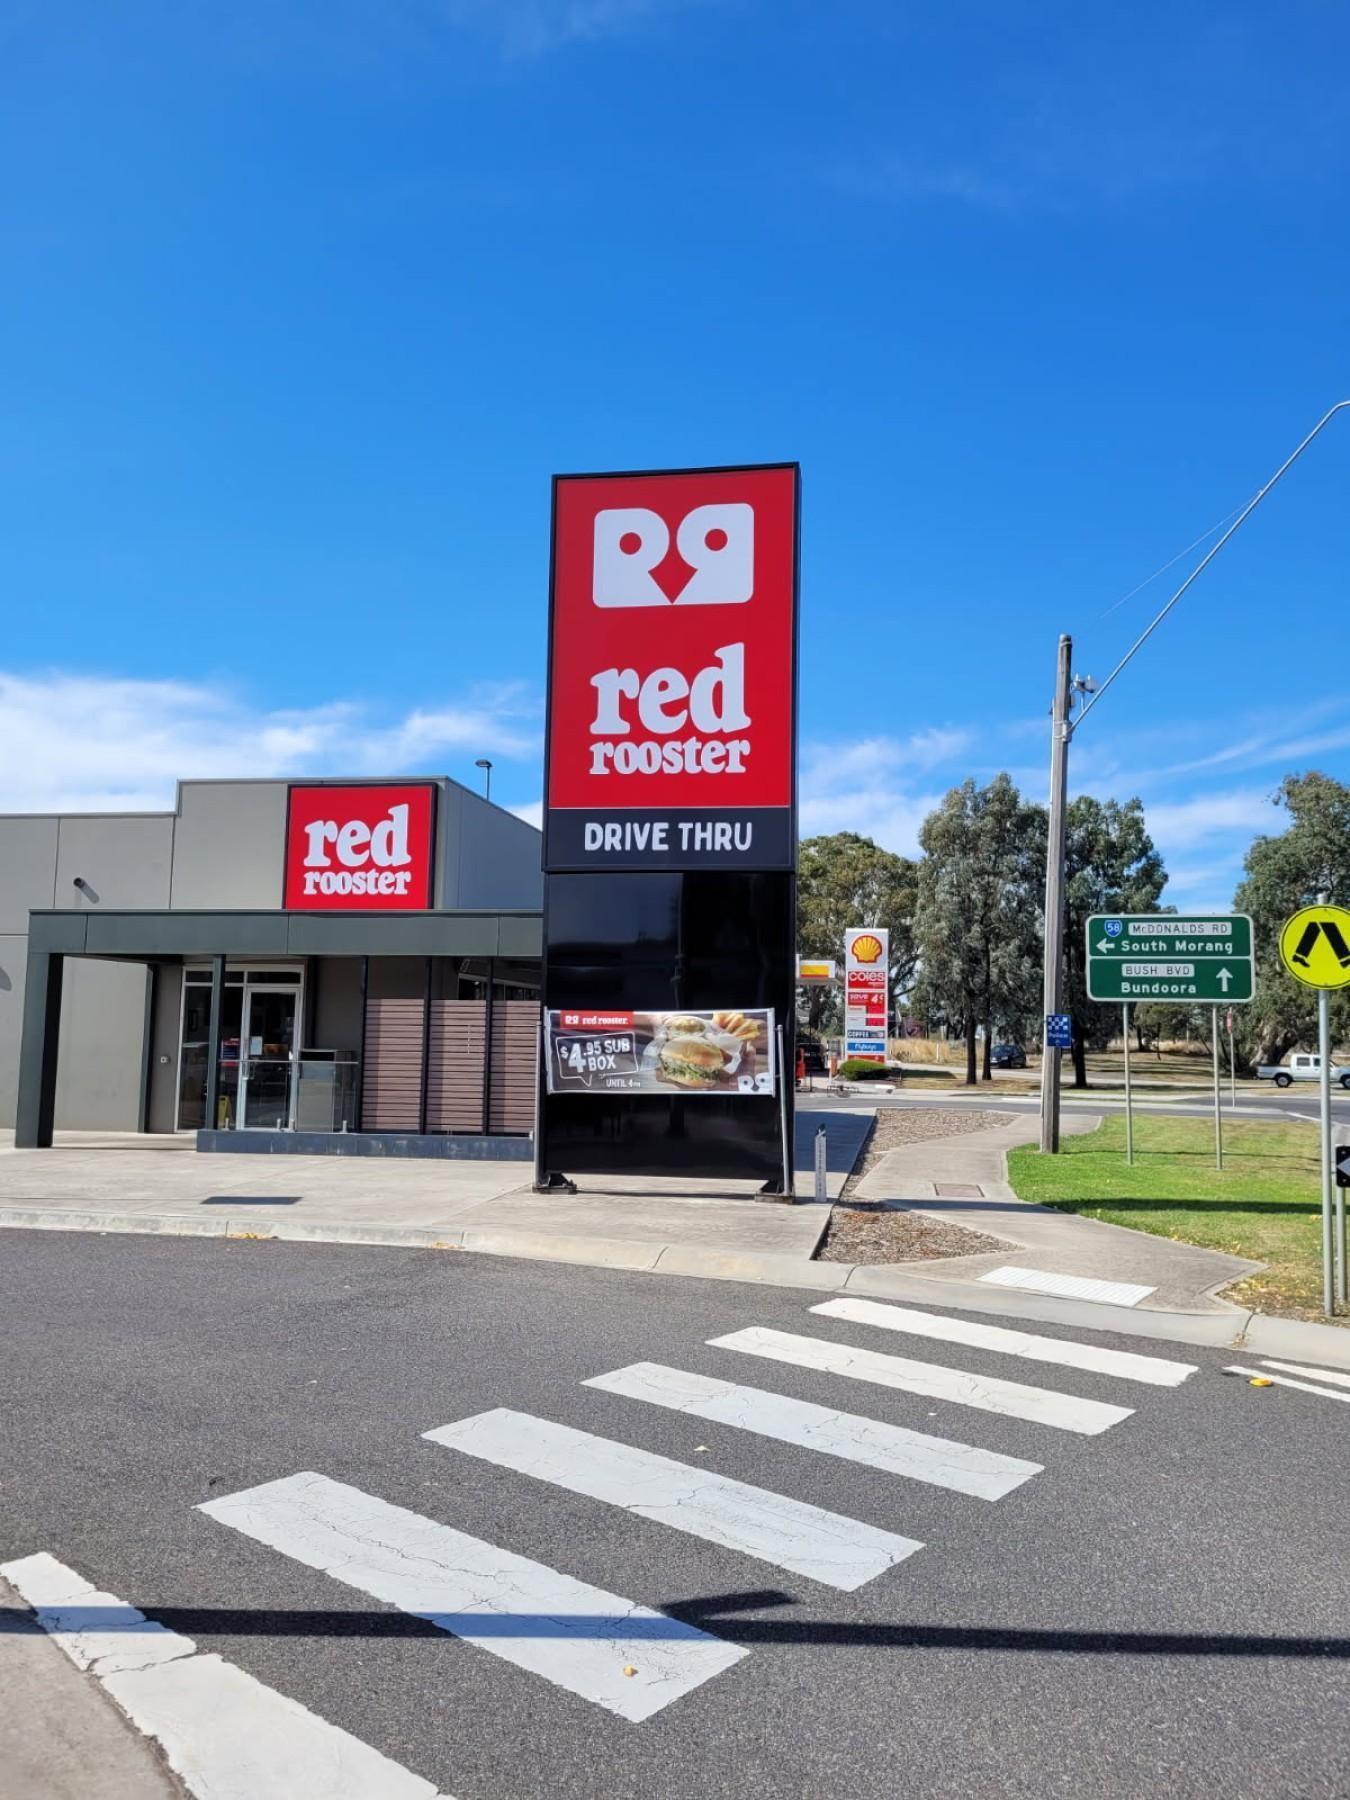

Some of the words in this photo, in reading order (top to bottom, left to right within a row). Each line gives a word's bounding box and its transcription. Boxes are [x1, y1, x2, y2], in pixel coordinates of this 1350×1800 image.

[589, 642, 751, 735] red
[589, 736, 751, 775] rooster
[303, 803, 412, 867] red
[584, 822, 669, 851] DRIVE
[678, 822, 753, 851] THRU
[303, 868, 412, 895] rooster
[1107, 923, 1120, 933] 58
[1132, 924, 1205, 934] McDONALDS
[1212, 924, 1228, 934] RD
[1121, 940, 1167, 952] South
[1175, 940, 1233, 955] Morang
[1126, 966, 1158, 976] BUSH
[1166, 966, 1190, 976] BVD
[1121, 981, 1197, 994] Bundoora
[582, 1015, 597, 1025] red
[604, 1038, 631, 1054] SUB
[588, 1055, 617, 1072] BOX
[606, 1079, 627, 1088] UNTIL
